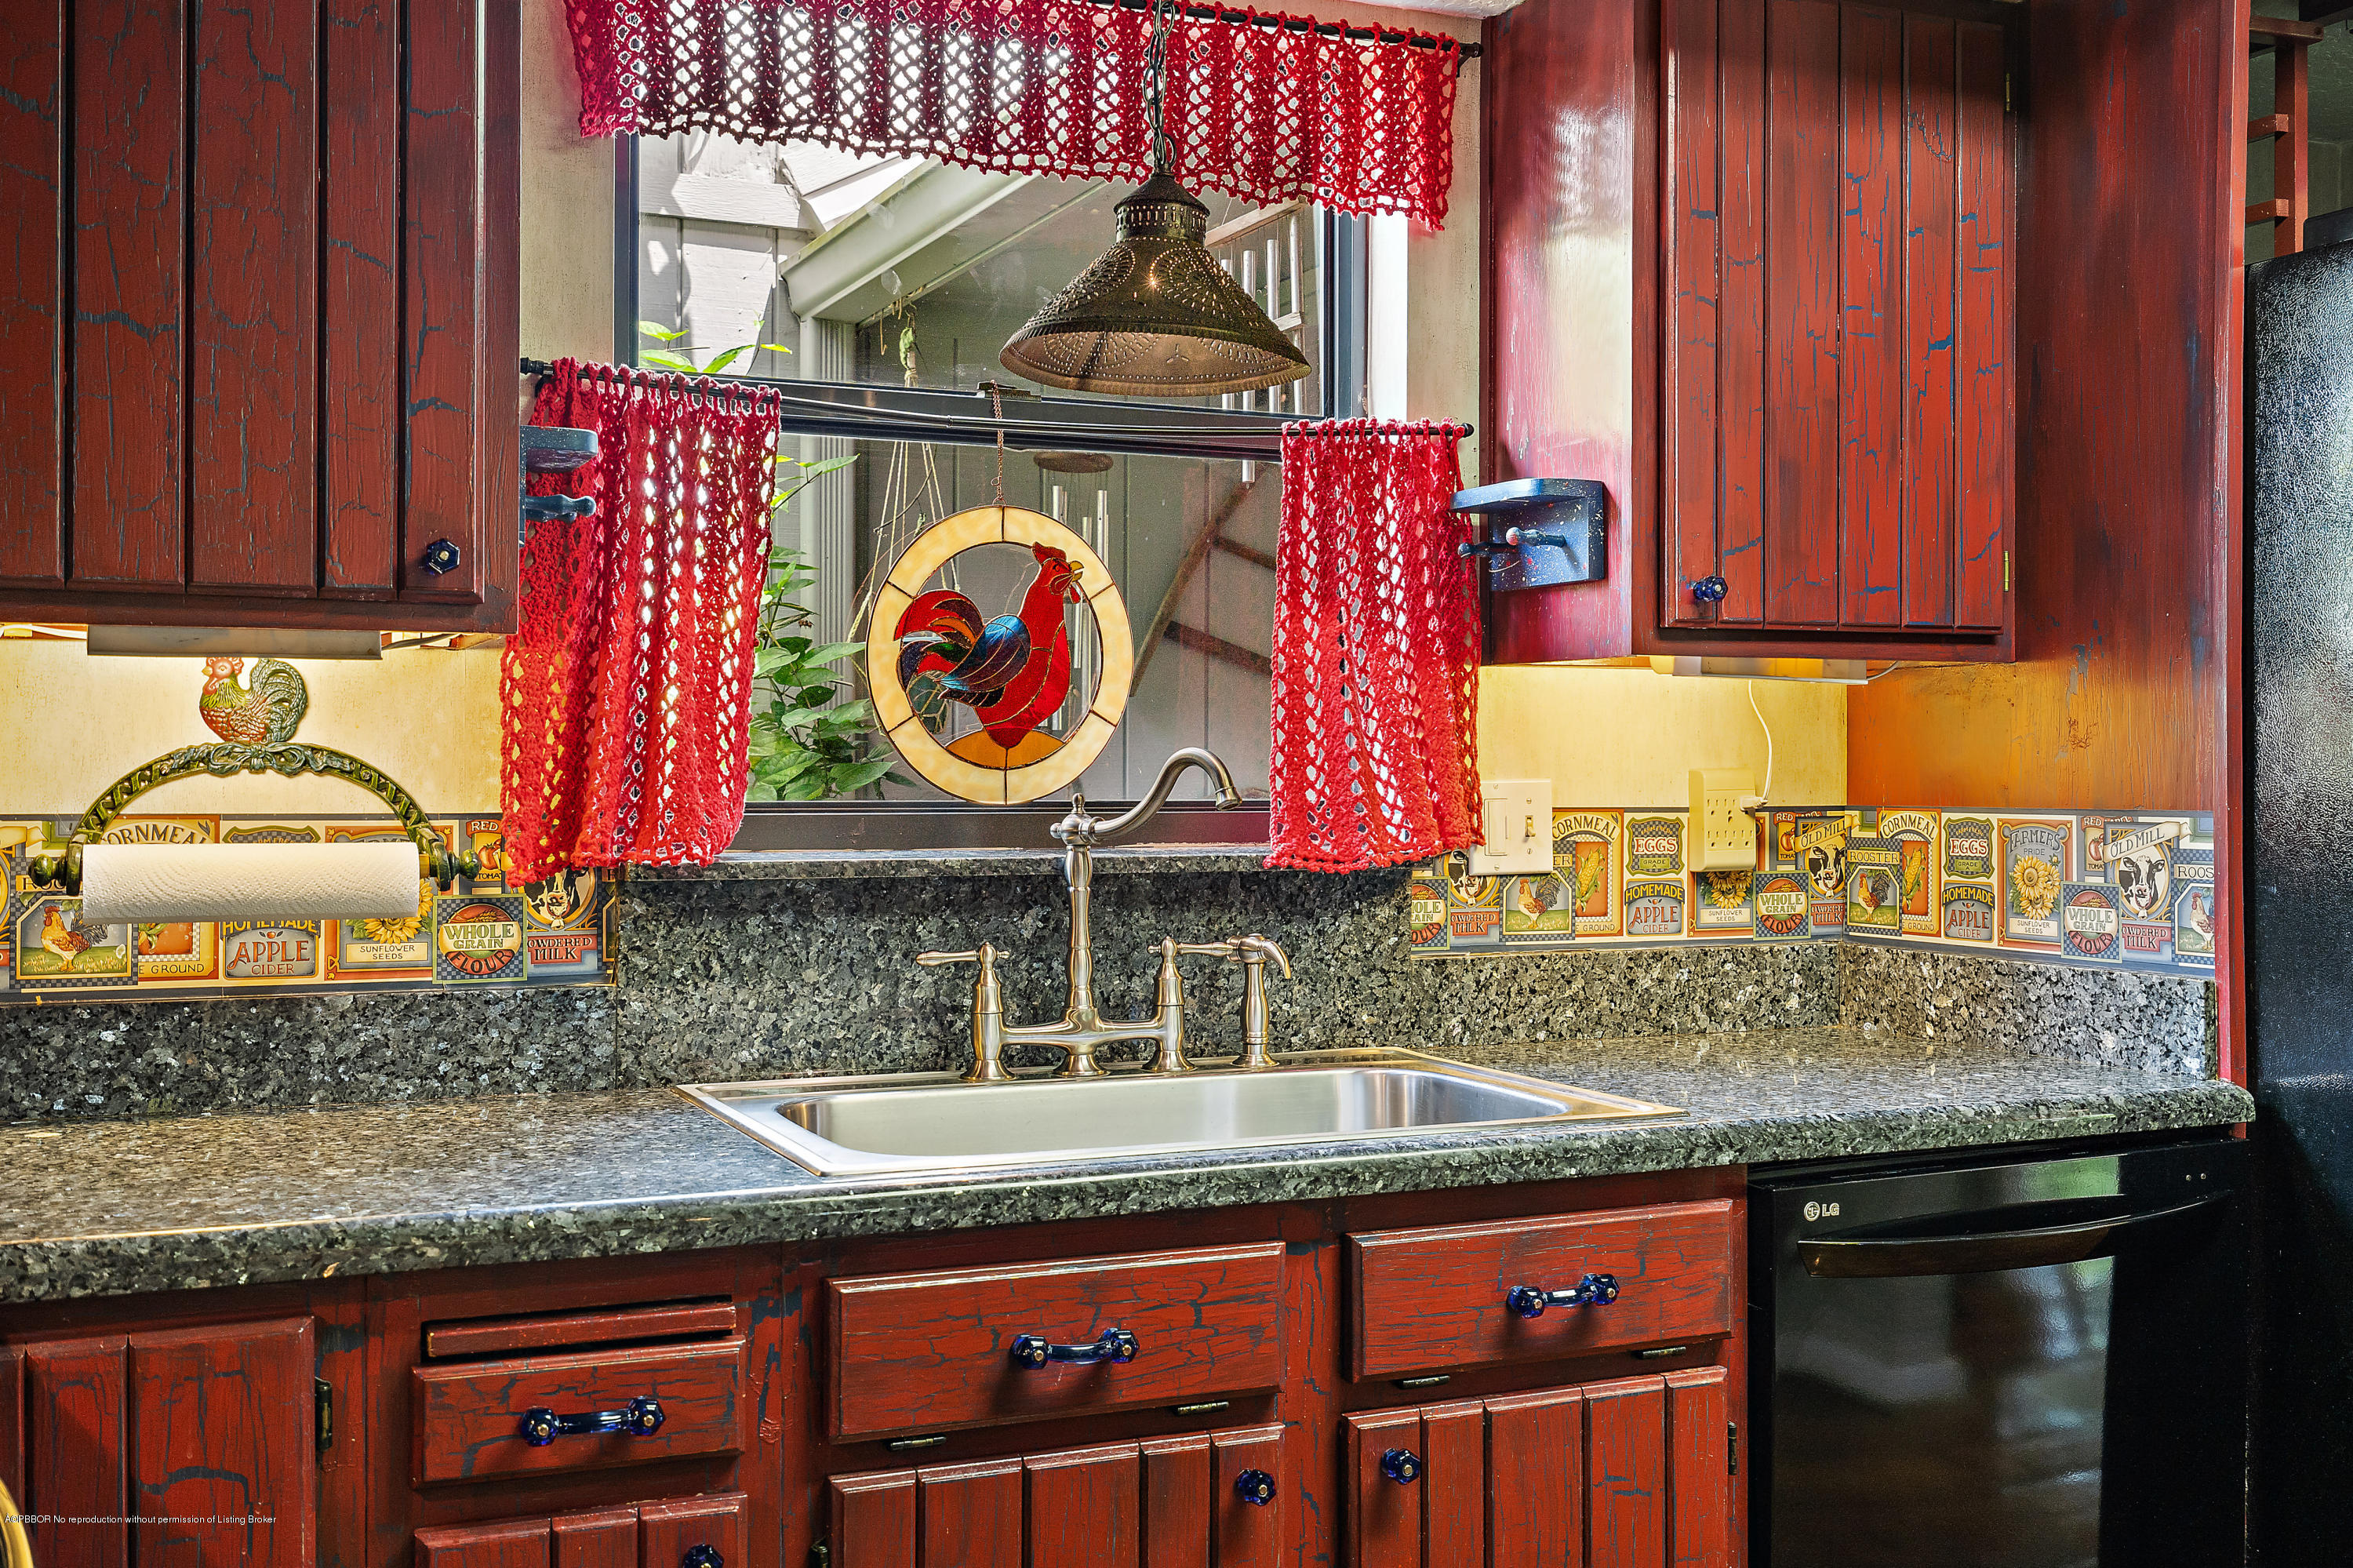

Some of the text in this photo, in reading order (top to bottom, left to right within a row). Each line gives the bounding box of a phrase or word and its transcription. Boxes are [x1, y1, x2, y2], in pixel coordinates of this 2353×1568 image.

[1777, 813, 1793, 821] RED
[2083, 817, 2102, 827] RED
[471, 821, 499, 831] RED
[1552, 816, 1616, 840] CORNMEAL
[1882, 815, 1936, 840] CORNMEAL
[100, 824, 206, 844] ORNMEA
[1801, 831, 1822, 847] OLD
[1635, 838, 1677, 853] EGGS
[1950, 839, 1988, 856] EGGS
[2009, 830, 2061, 853] FARMERS
[2110, 828, 2165, 857] OLD MILL
[1849, 852, 1899, 863] ROOSTER
[1626, 884, 1684, 901] HOMEMADE
[1943, 887, 1994, 906] HOMEMADE
[1759, 893, 1803, 906] WHOLE
[1766, 905, 1796, 914] GRAIN
[2067, 908, 2113, 923] WHOLE
[1628, 906, 1678, 929] APPLE
[1764, 914, 1802, 932] FLOUR
[1816, 913, 1842, 922] MILK
[1945, 909, 1990, 931] APPLE
[1456, 922, 1486, 933] MILK
[1583, 923, 1616, 932] GROUND
[1643, 924, 1669, 933] CIDER
[1908, 922, 1934, 931] GROUND
[2017, 920, 2050, 929] SUNFLOWER
[2074, 922, 2106, 932] GRAIN
[444, 923, 515, 940] WHOLE
[1958, 928, 1981, 938] CIDER
[2122, 927, 2167, 937] OWDERED
[360, 944, 415, 953] SUNFLOWER
[453, 939, 504, 949] GRAIN
[527, 937, 592, 948] OWDERED
[2071, 933, 2113, 951] FLOUR
[2127, 936, 2157, 949] MILK
[226, 940, 311, 970] APPLE
[534, 948, 578, 961] MILK
[449, 950, 513, 973] FLOUR
[151, 963, 205, 974] GROUND
[251, 963, 295, 975] CIDER
[1822, 1202, 1840, 1217] LG
